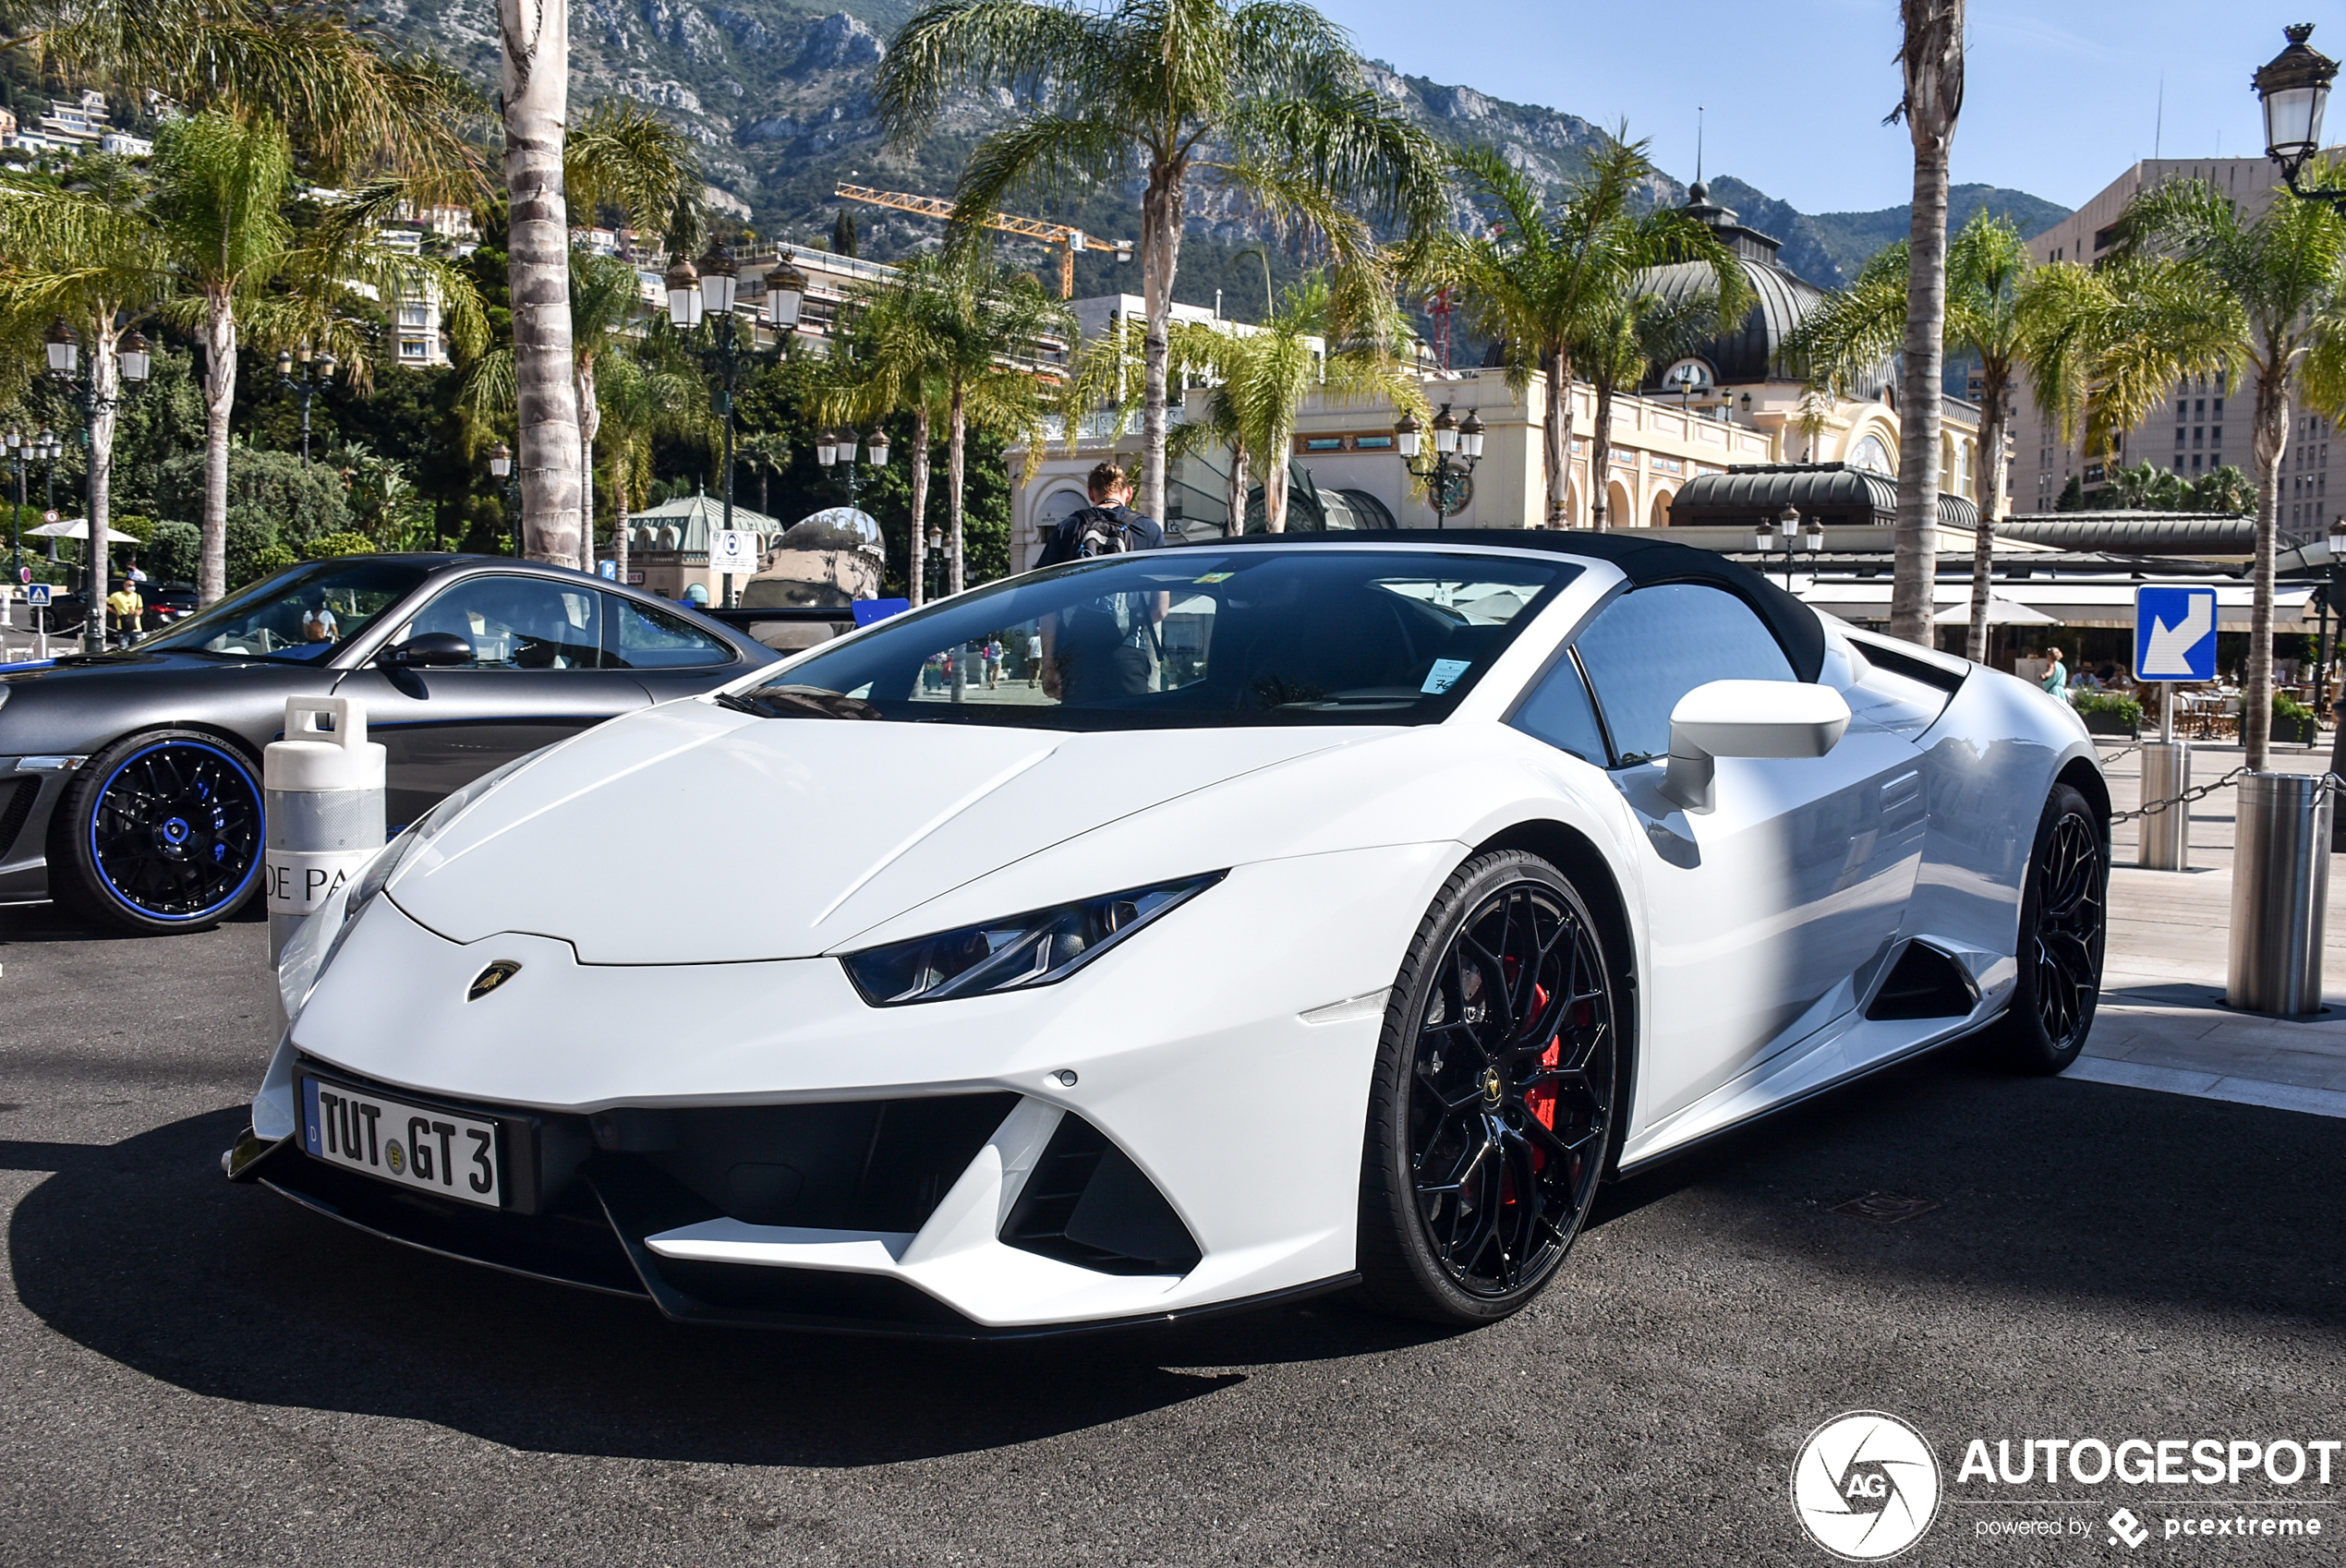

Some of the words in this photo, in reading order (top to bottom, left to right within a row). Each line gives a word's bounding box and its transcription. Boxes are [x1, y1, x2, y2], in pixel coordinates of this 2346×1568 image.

[606, 563, 613, 576] P
[306, 868, 346, 901] PA
[310, 1126, 317, 1141] D
[320, 1092, 381, 1166] TUT
[407, 1116, 455, 1187] GT
[466, 1128, 492, 1194] 3
